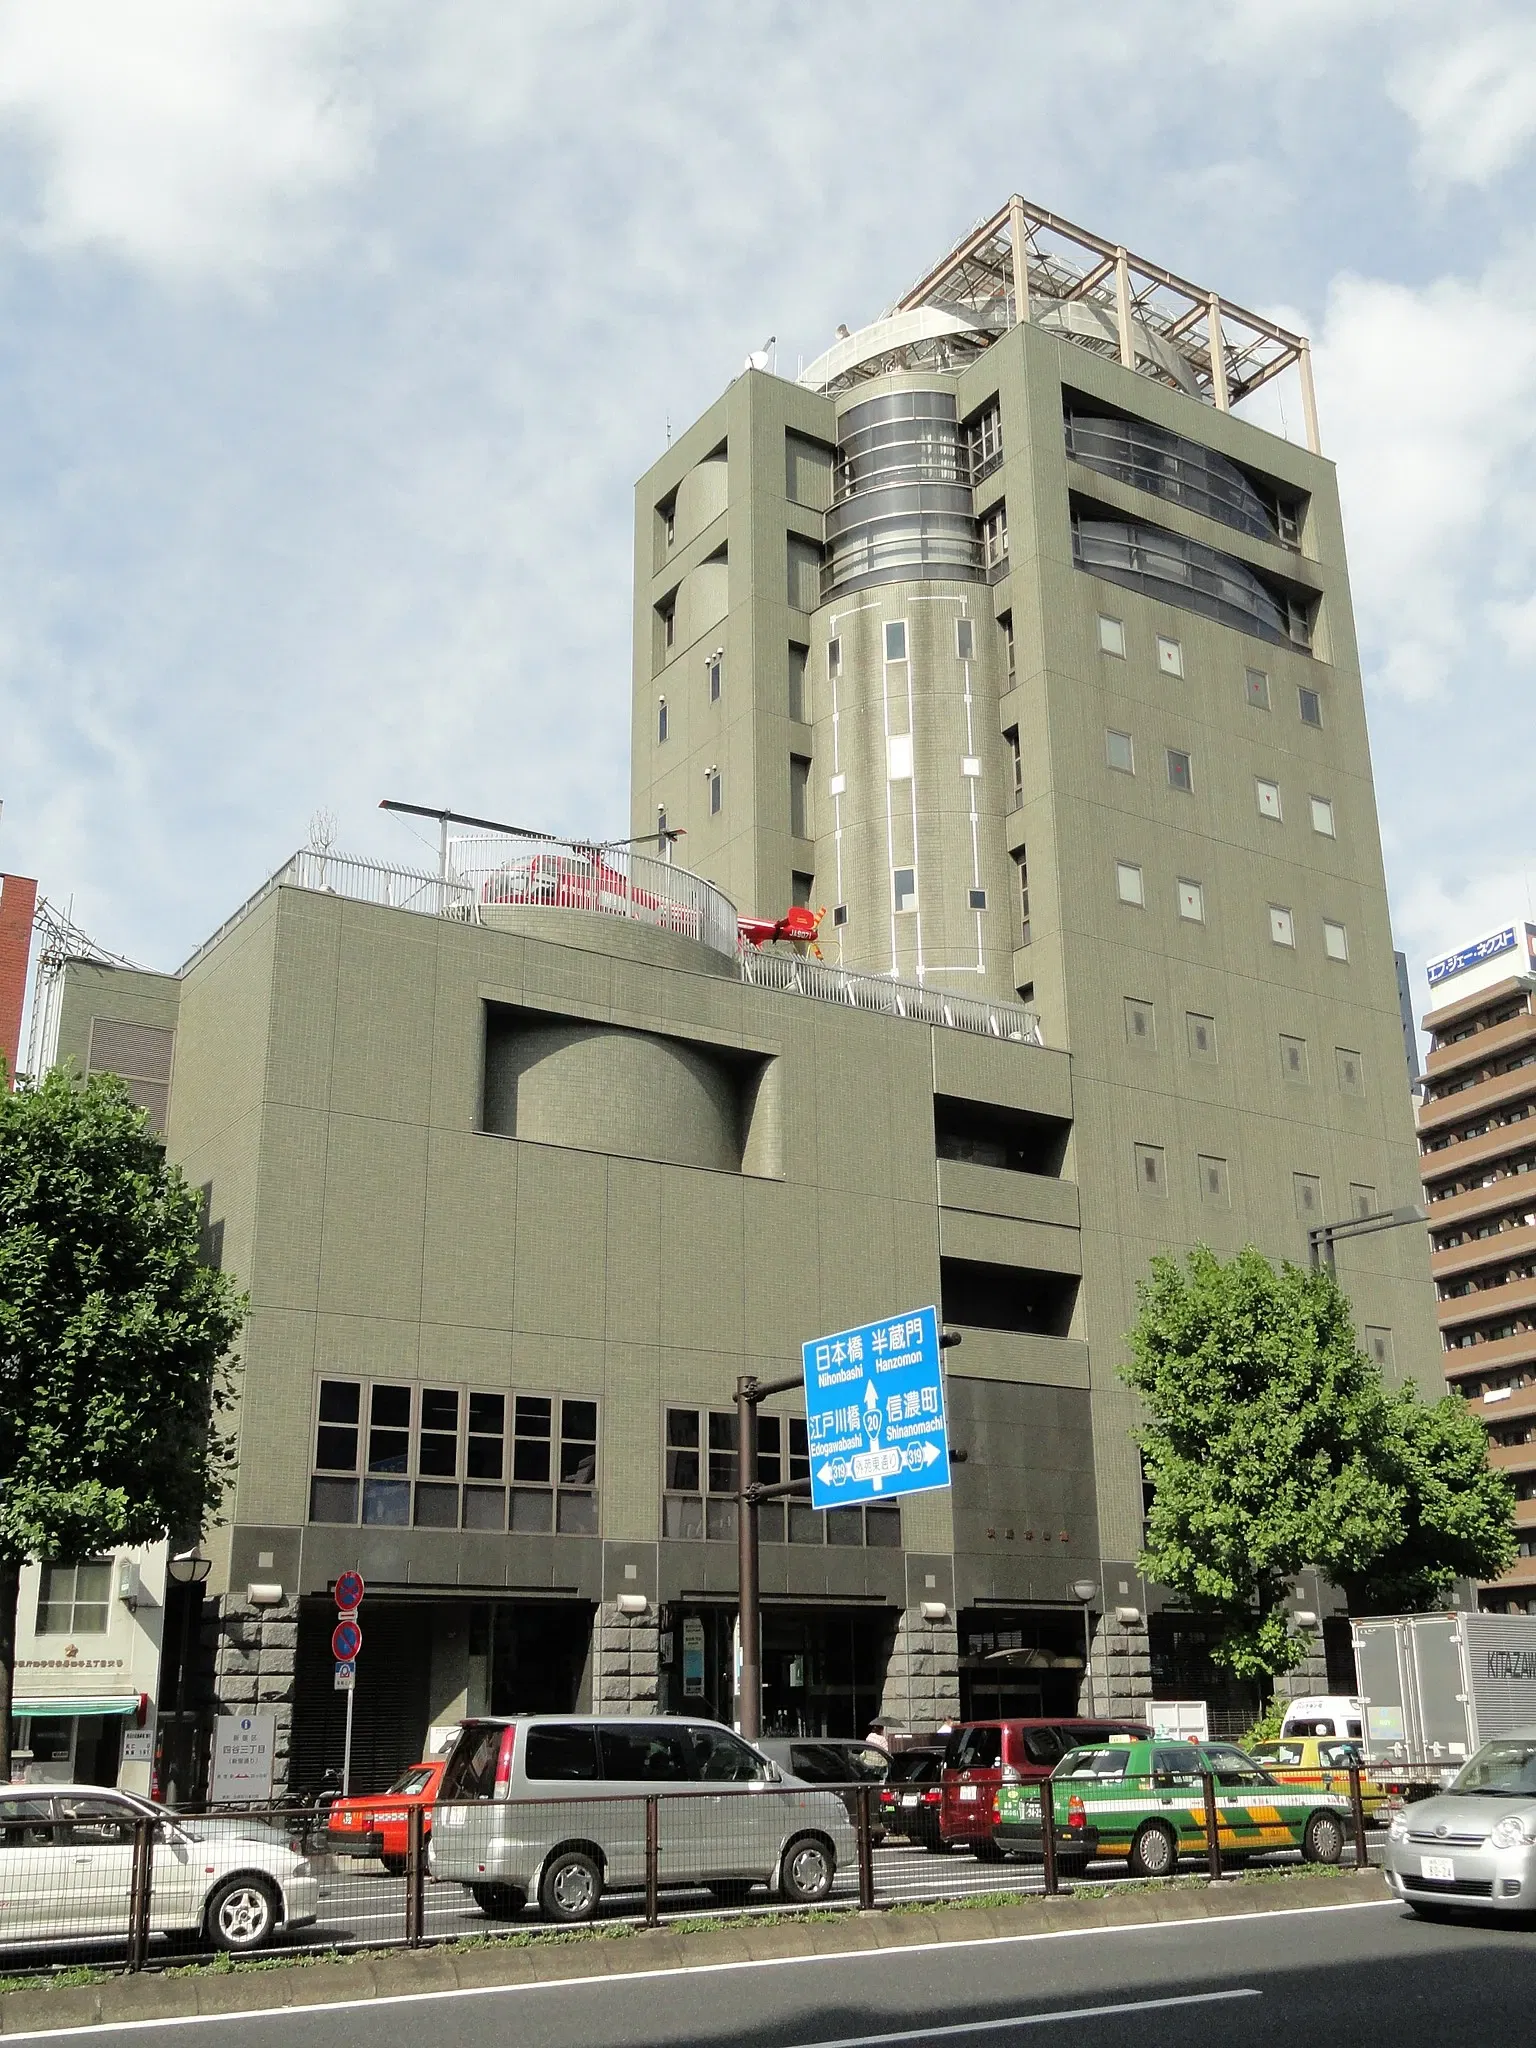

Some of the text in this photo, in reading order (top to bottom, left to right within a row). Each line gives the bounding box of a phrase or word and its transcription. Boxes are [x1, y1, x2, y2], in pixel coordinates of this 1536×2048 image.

[789, 929, 812, 939] JA9071
[1428, 932, 1513, 981] エフ・ジェー・ネクスト
[815, 1317, 923, 1372] 日本橋 半蔵門
[875, 1351, 922, 1374] Hanzomon
[818, 1364, 863, 1388] Nihonbashi
[886, 1386, 938, 1423] 信濃町
[809, 1404, 860, 1440] 江戸川橋
[867, 1414, 879, 1432] 20
[886, 1415, 944, 1441] Shinanomachi
[811, 1433, 862, 1457] Edogawabashi
[908, 1449, 921, 1465] 319
[833, 1464, 845, 1479] 319
[223, 1745, 266, 1754] 四谷三丁目
